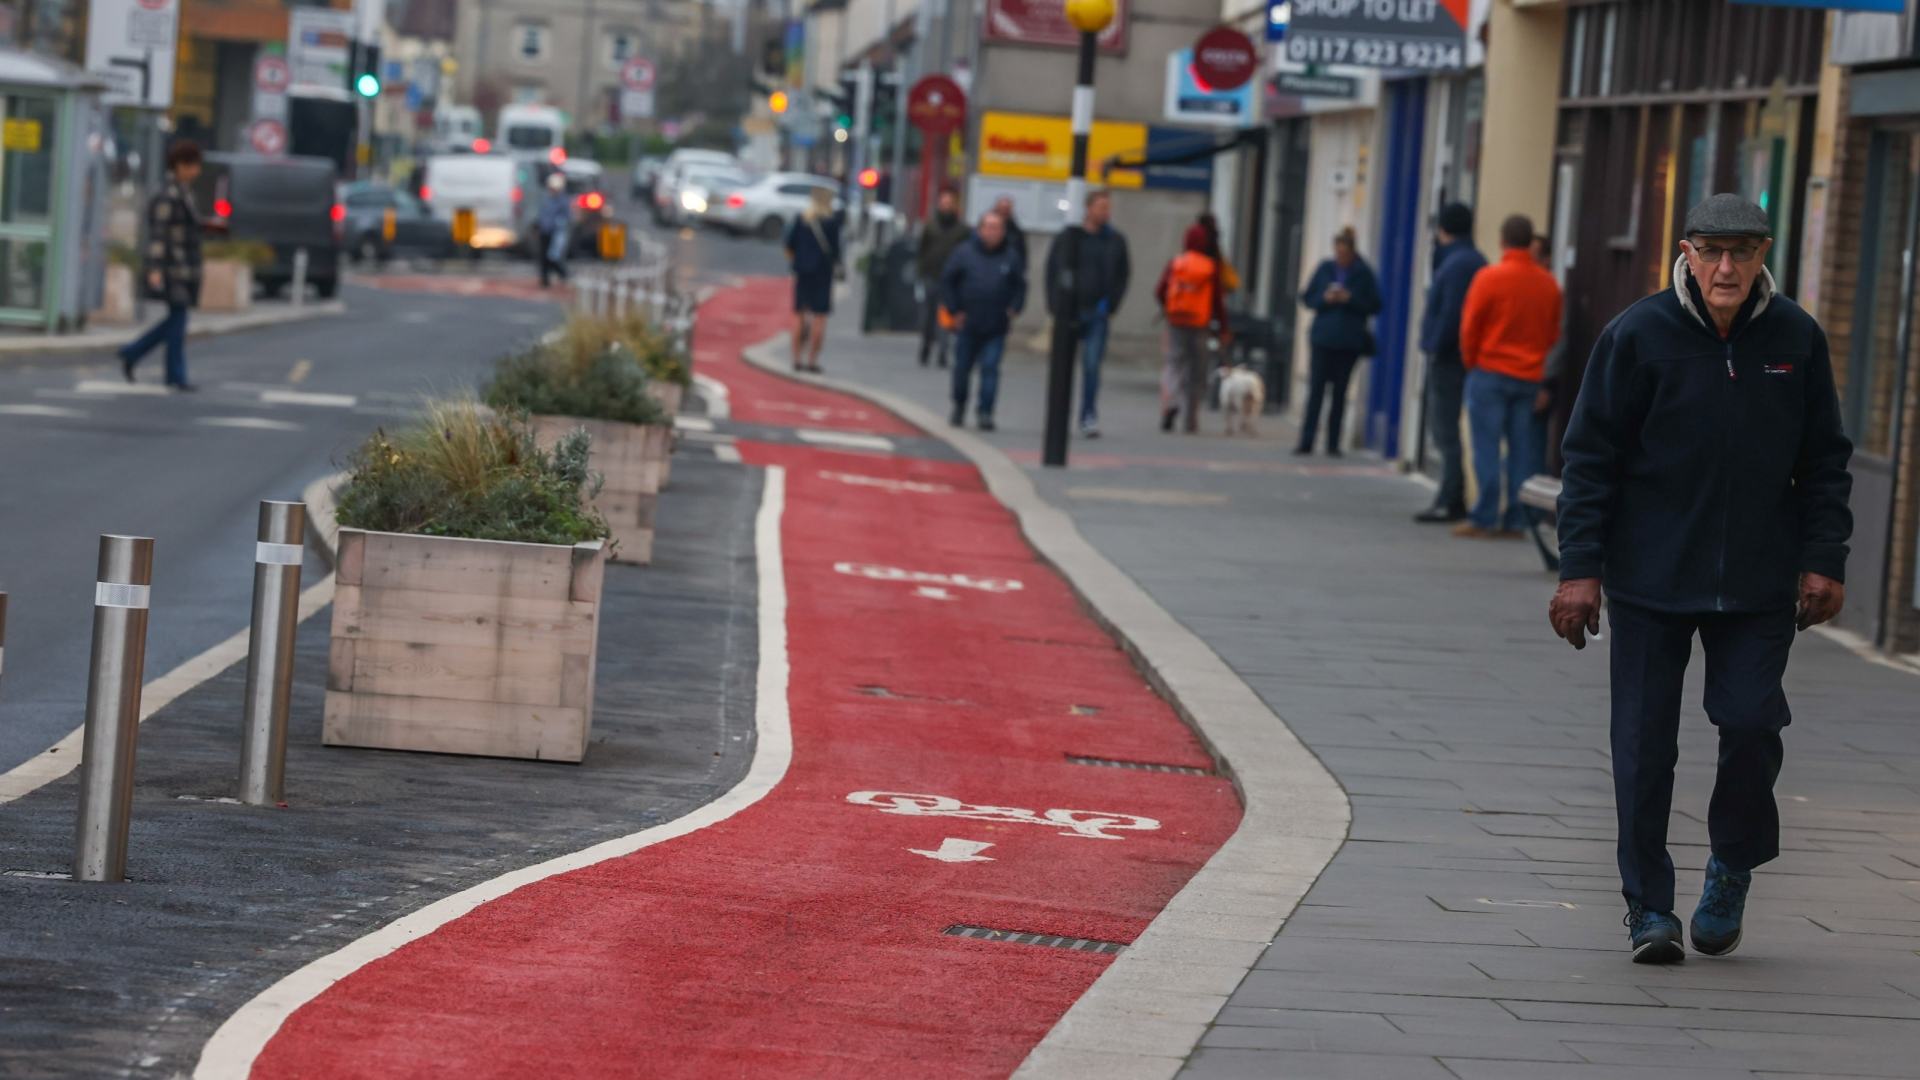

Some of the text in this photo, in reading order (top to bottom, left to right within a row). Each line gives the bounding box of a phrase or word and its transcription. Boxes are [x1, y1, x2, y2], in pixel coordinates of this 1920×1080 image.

[1292, 0, 1436, 23] SHOP TO LET
[1290, 35, 1461, 69] 0117 923 9234
